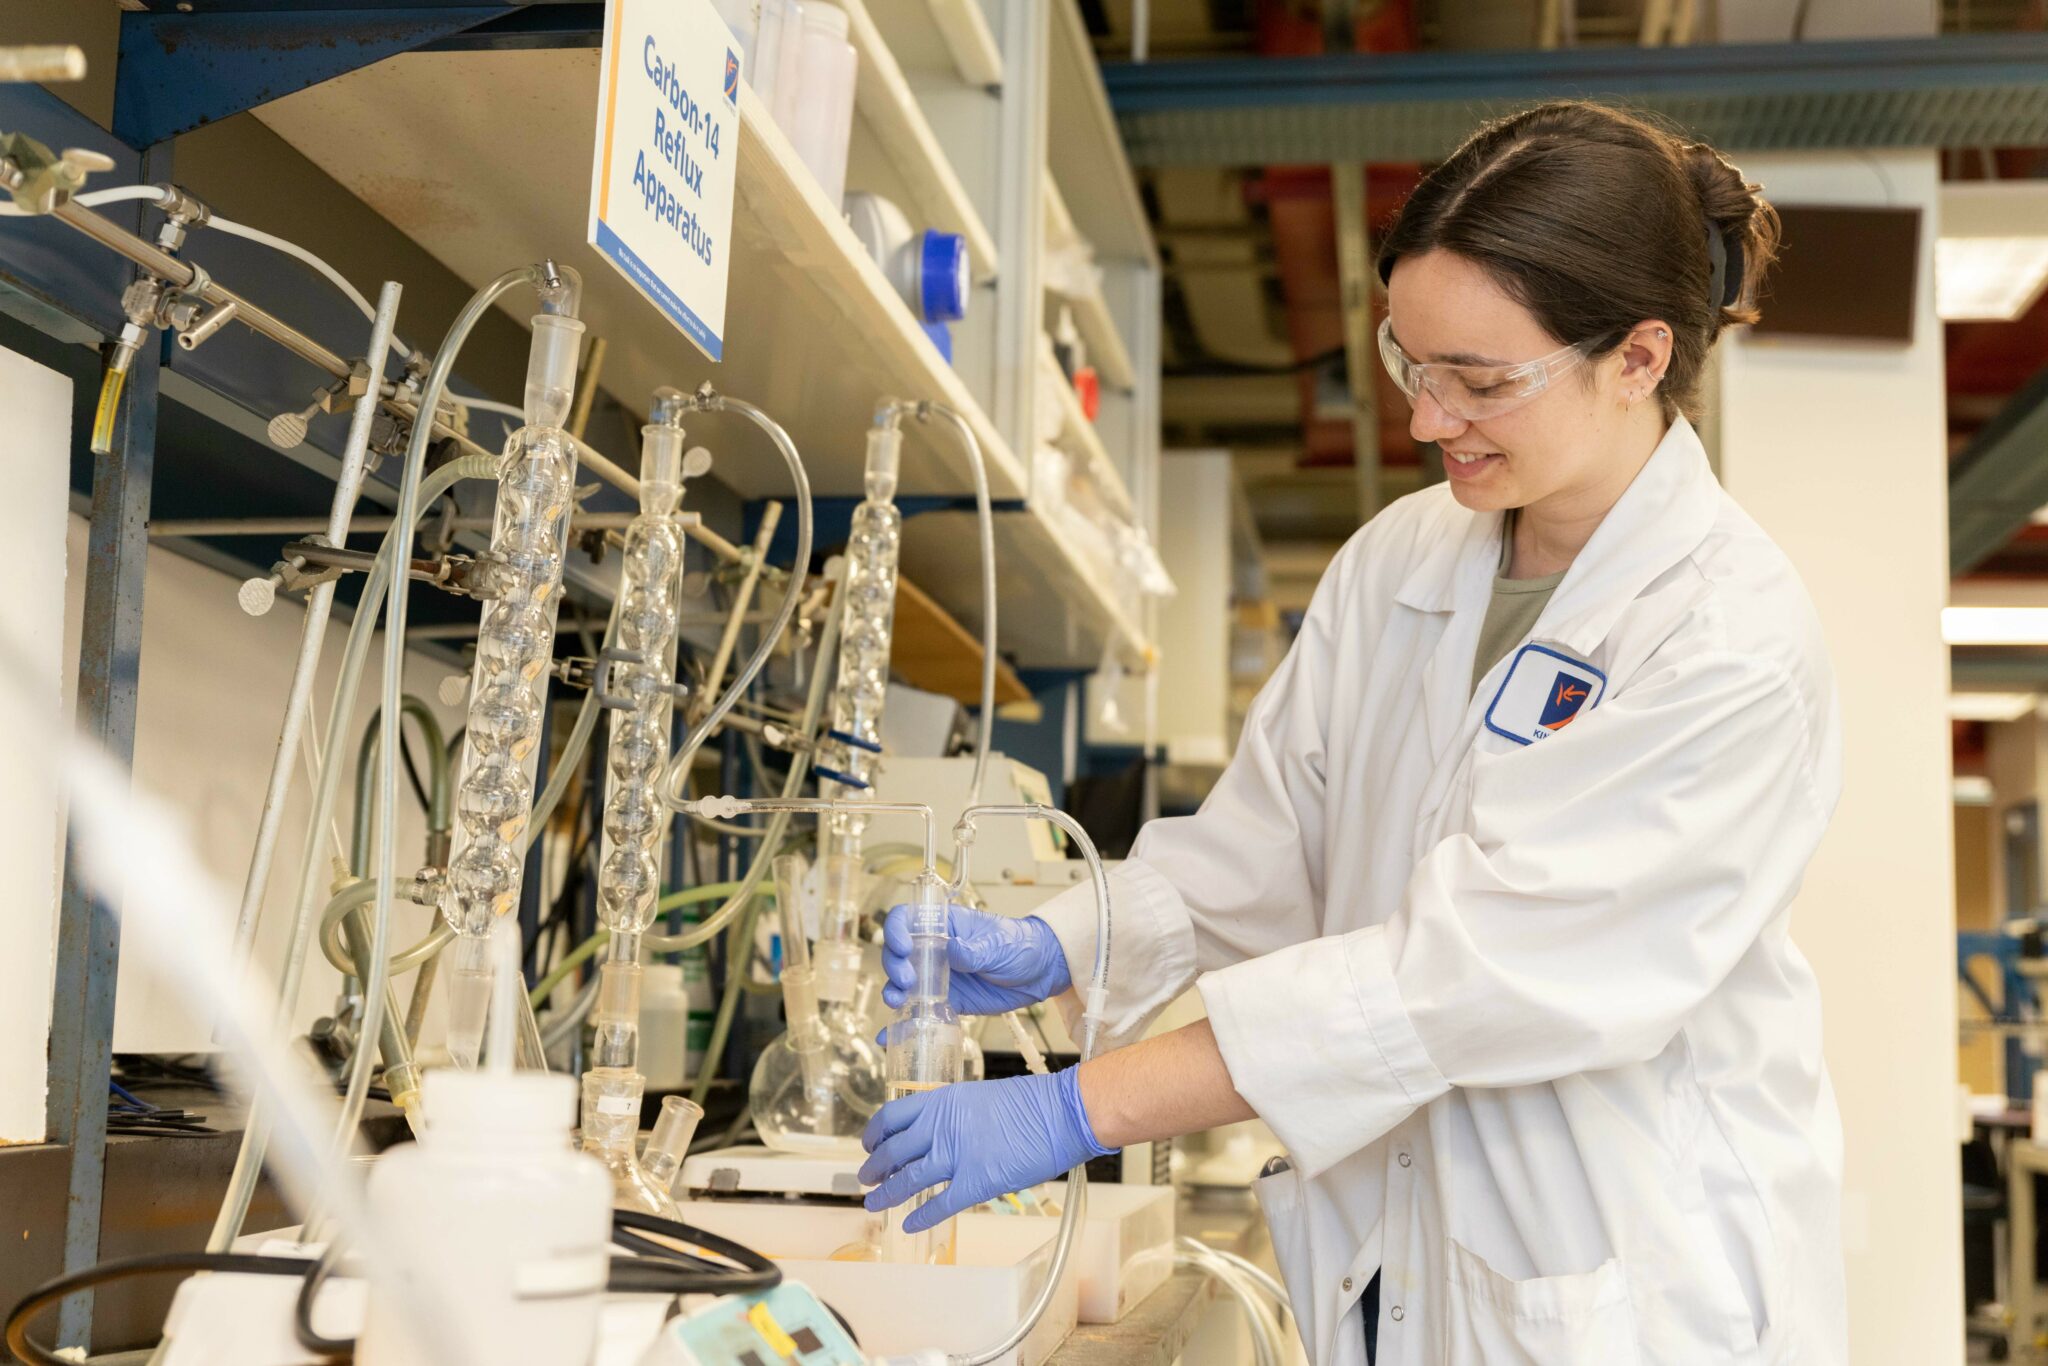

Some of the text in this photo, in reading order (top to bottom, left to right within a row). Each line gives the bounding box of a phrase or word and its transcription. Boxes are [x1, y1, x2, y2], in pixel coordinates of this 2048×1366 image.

[644, 35, 719, 160] Carbon-14
[654, 107, 702, 199] Reflux
[633, 149, 712, 266] Apparatus
